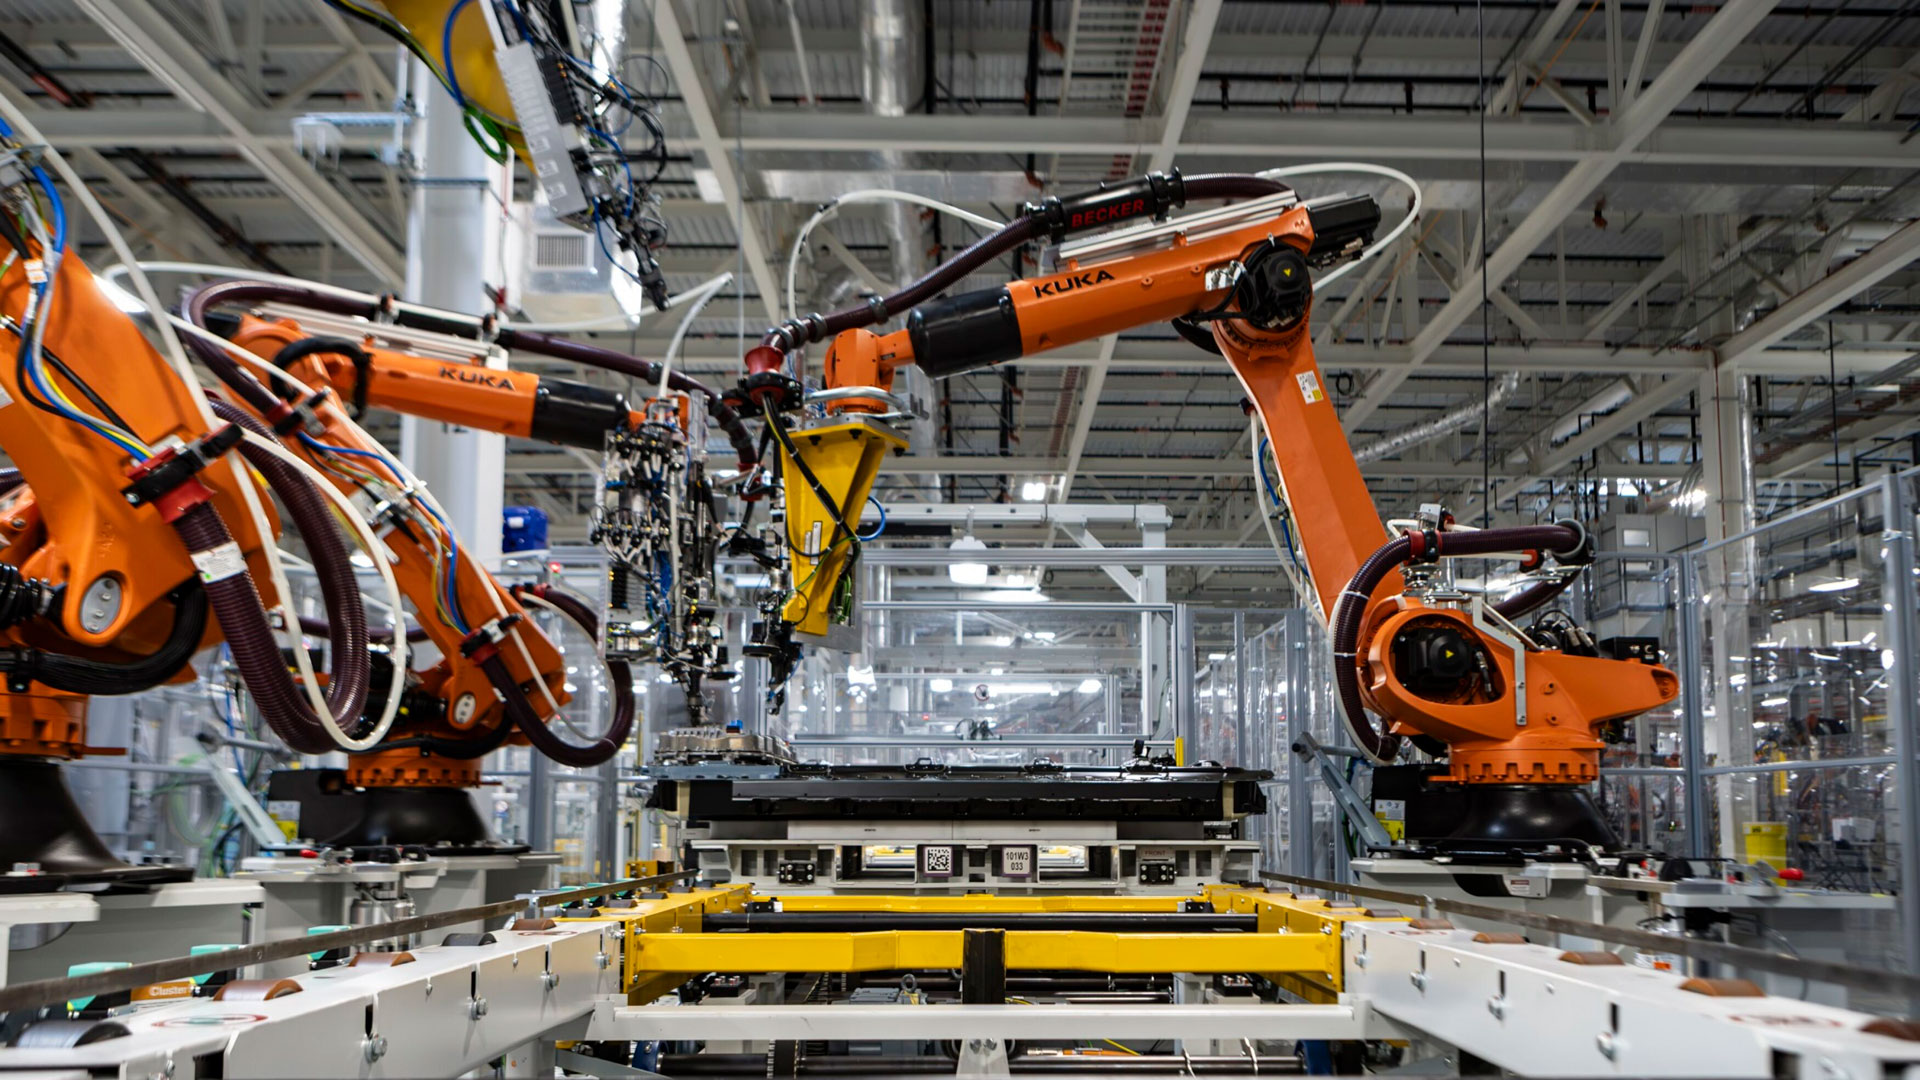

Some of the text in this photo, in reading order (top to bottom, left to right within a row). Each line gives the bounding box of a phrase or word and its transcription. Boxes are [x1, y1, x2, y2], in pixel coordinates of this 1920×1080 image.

[1071, 199, 1144, 228] BECKER
[1033, 269, 1115, 298] KUKA
[439, 367, 515, 390] KUKA
[1006, 851, 1029, 861] 101W3
[1010, 862, 1023, 871] 033
[150, 985, 187, 996] Cluster
